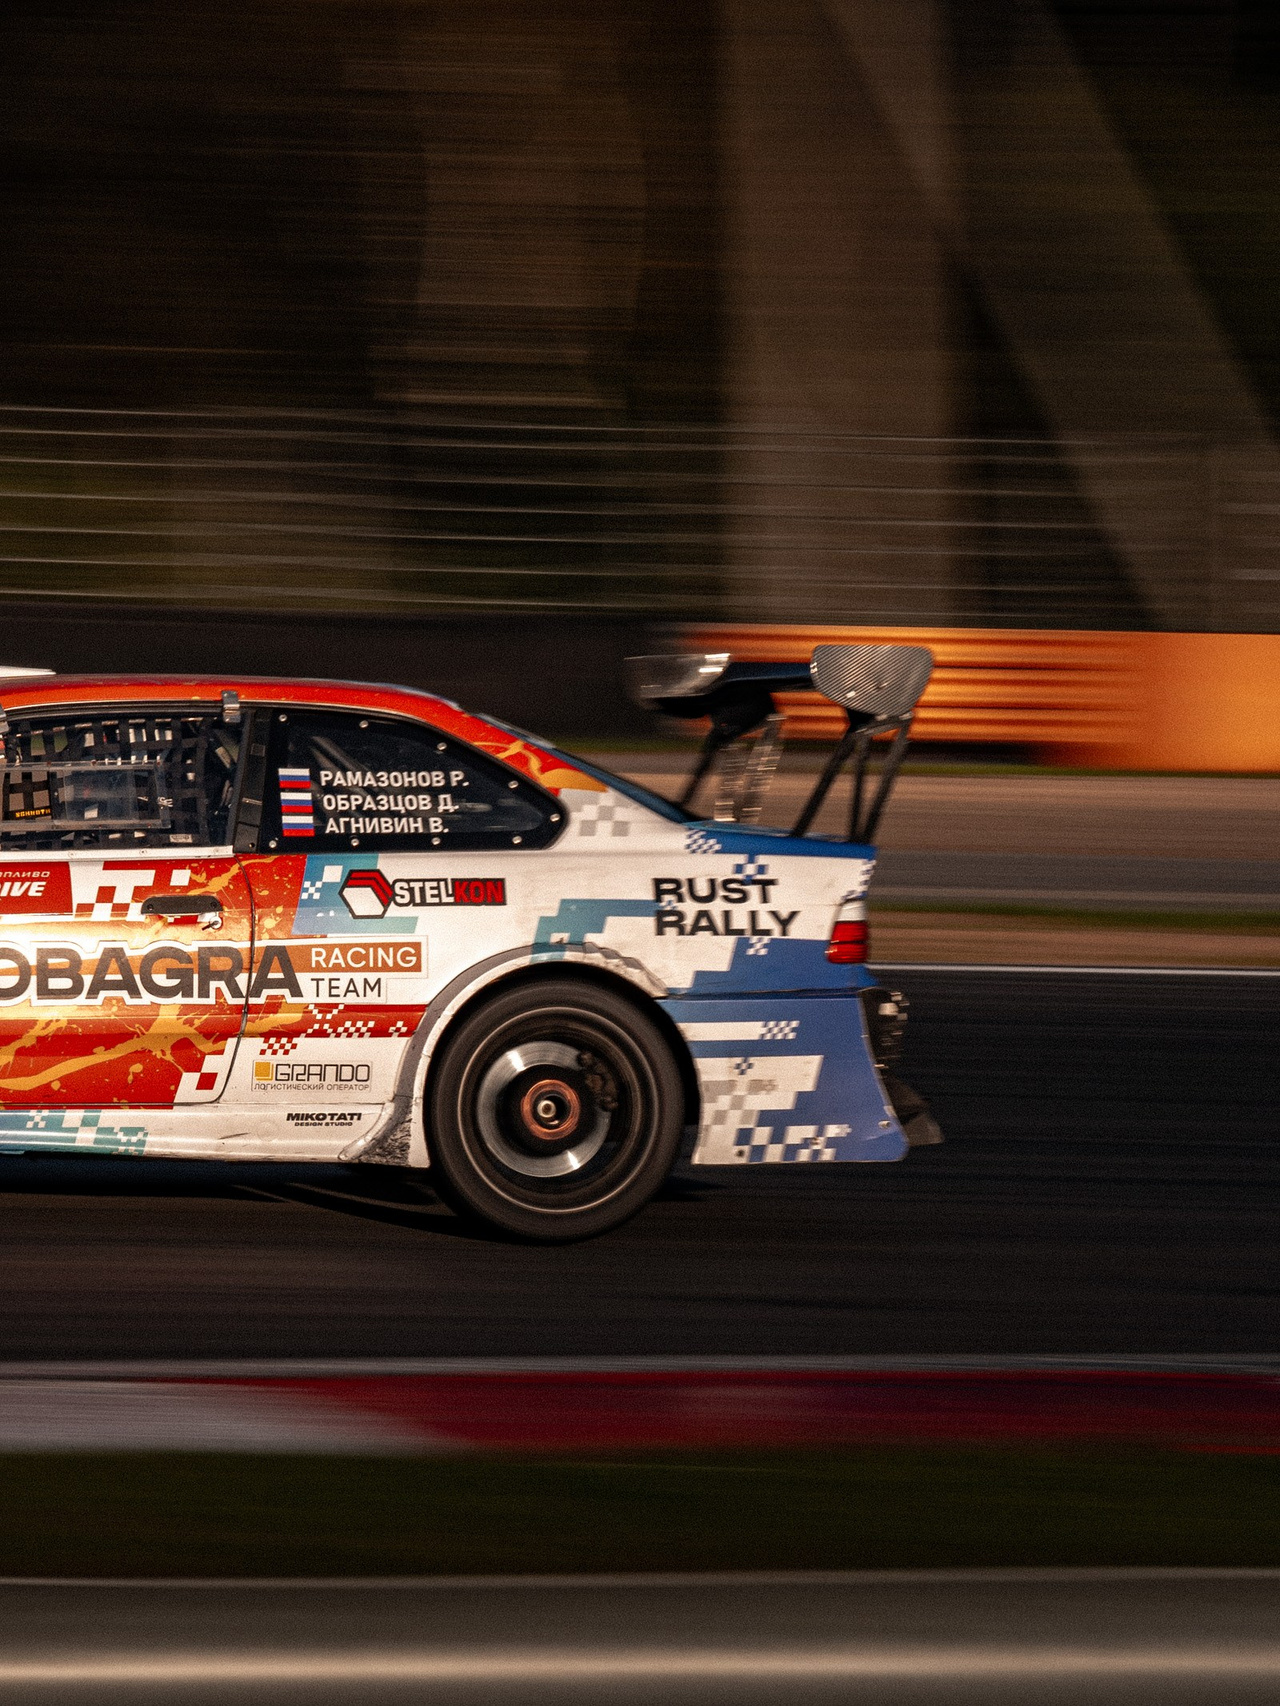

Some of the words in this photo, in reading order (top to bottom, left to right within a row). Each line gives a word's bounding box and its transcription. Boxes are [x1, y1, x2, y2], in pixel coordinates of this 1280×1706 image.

[320, 770, 445, 788] РАМАЗОНОВ
[450, 770, 470, 788] Р.
[323, 794, 433, 814] ОБРАЗЦОВ
[437, 794, 460, 813] Д.
[325, 817, 424, 834] АГНИВИН
[428, 817, 450, 834] В.
[393, 880, 505, 904] STELKON
[652, 877, 779, 904] RUST
[655, 909, 801, 937] RALLY
[311, 946, 417, 968] RACING
[311, 977, 382, 998] TEAM
[275, 1063, 371, 1082] GRANDO
[254, 1082, 324, 1091] ЛОГИСТИЧЕСКИЙ
[326, 1083, 370, 1091] ОПЕРАТОР
[286, 1112, 362, 1121] MIKOTATI
